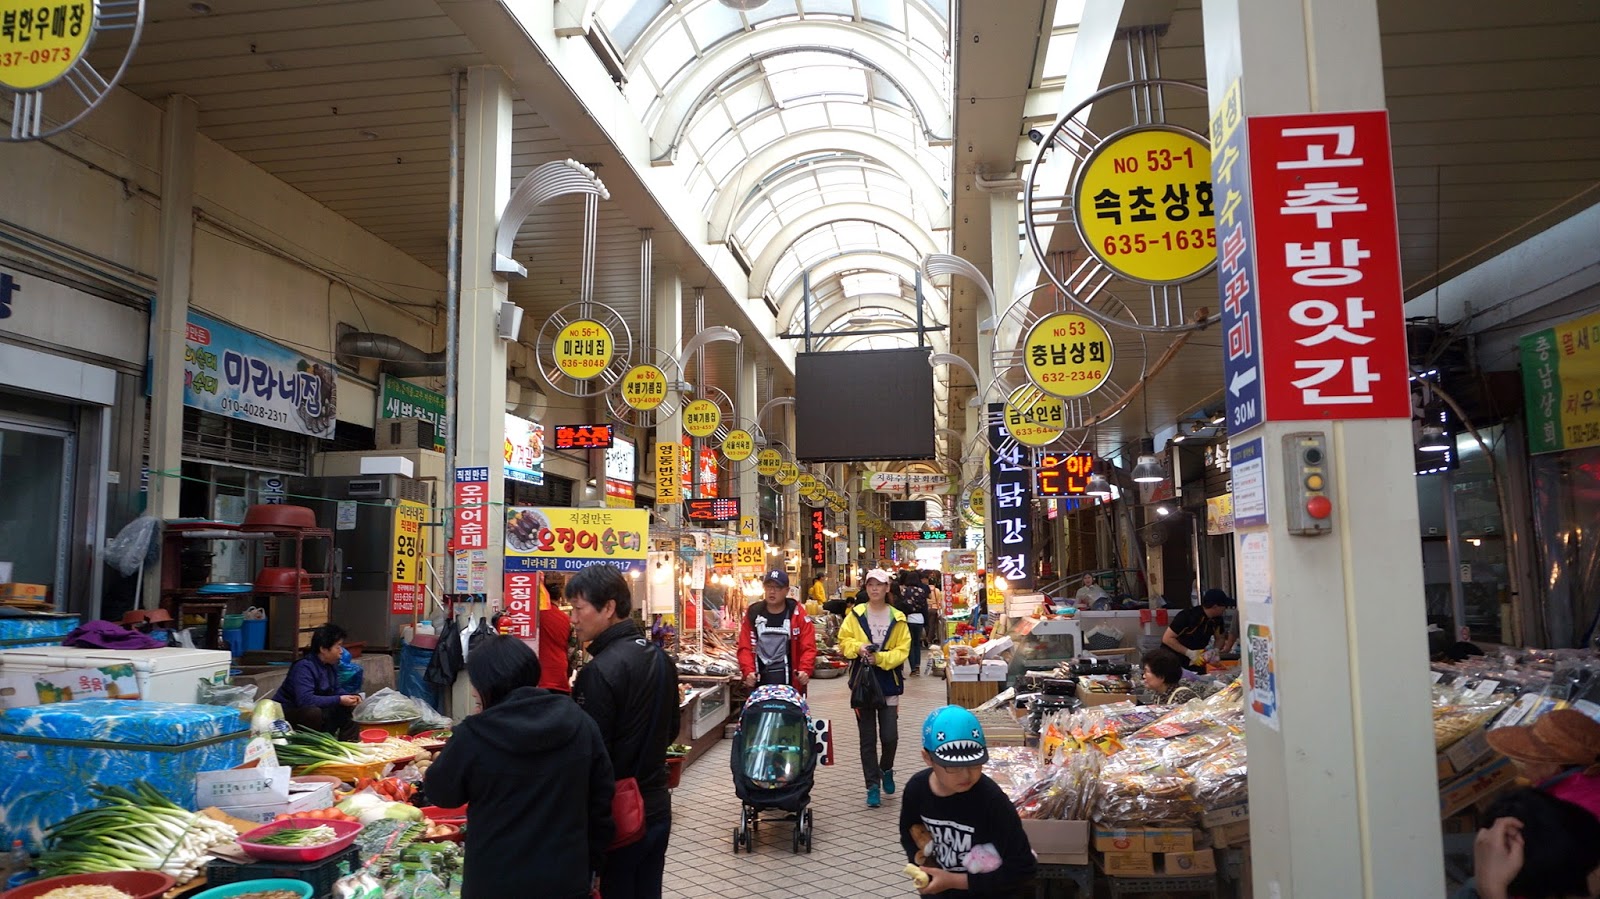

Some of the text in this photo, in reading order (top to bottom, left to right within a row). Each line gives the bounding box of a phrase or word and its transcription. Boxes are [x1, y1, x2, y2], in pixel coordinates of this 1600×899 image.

[1114, 147, 1194, 174] NO 53-1
[1104, 228, 1216, 256] 635-1635
[1217, 145, 1253, 362] 수수부꾸미
[1276, 125, 1381, 405] 고추방앗간
[570, 328, 600, 337] NO 56-1
[1054, 322, 1086, 337] NO 53
[564, 340, 605, 356] 미라네집
[1032, 341, 1105, 367] 충남상회
[562, 359, 605, 368] 636-8048
[645, 371, 655, 379] 56
[1042, 370, 1102, 383] 632-2346
[224, 351, 320, 416] 미라네집
[221, 397, 288, 424] 010-4028-2317
[1009, 405, 1062, 425] 금산인삼
[1234, 399, 1256, 426] 30M
[457, 469, 488, 481] 직접만든
[460, 485, 483, 546] 오징어순대
[569, 513, 612, 525] 직접만든
[537, 527, 640, 555] 오징어순대
[521, 558, 558, 569] 미라네집
[509, 576, 532, 636] 오징어순대
